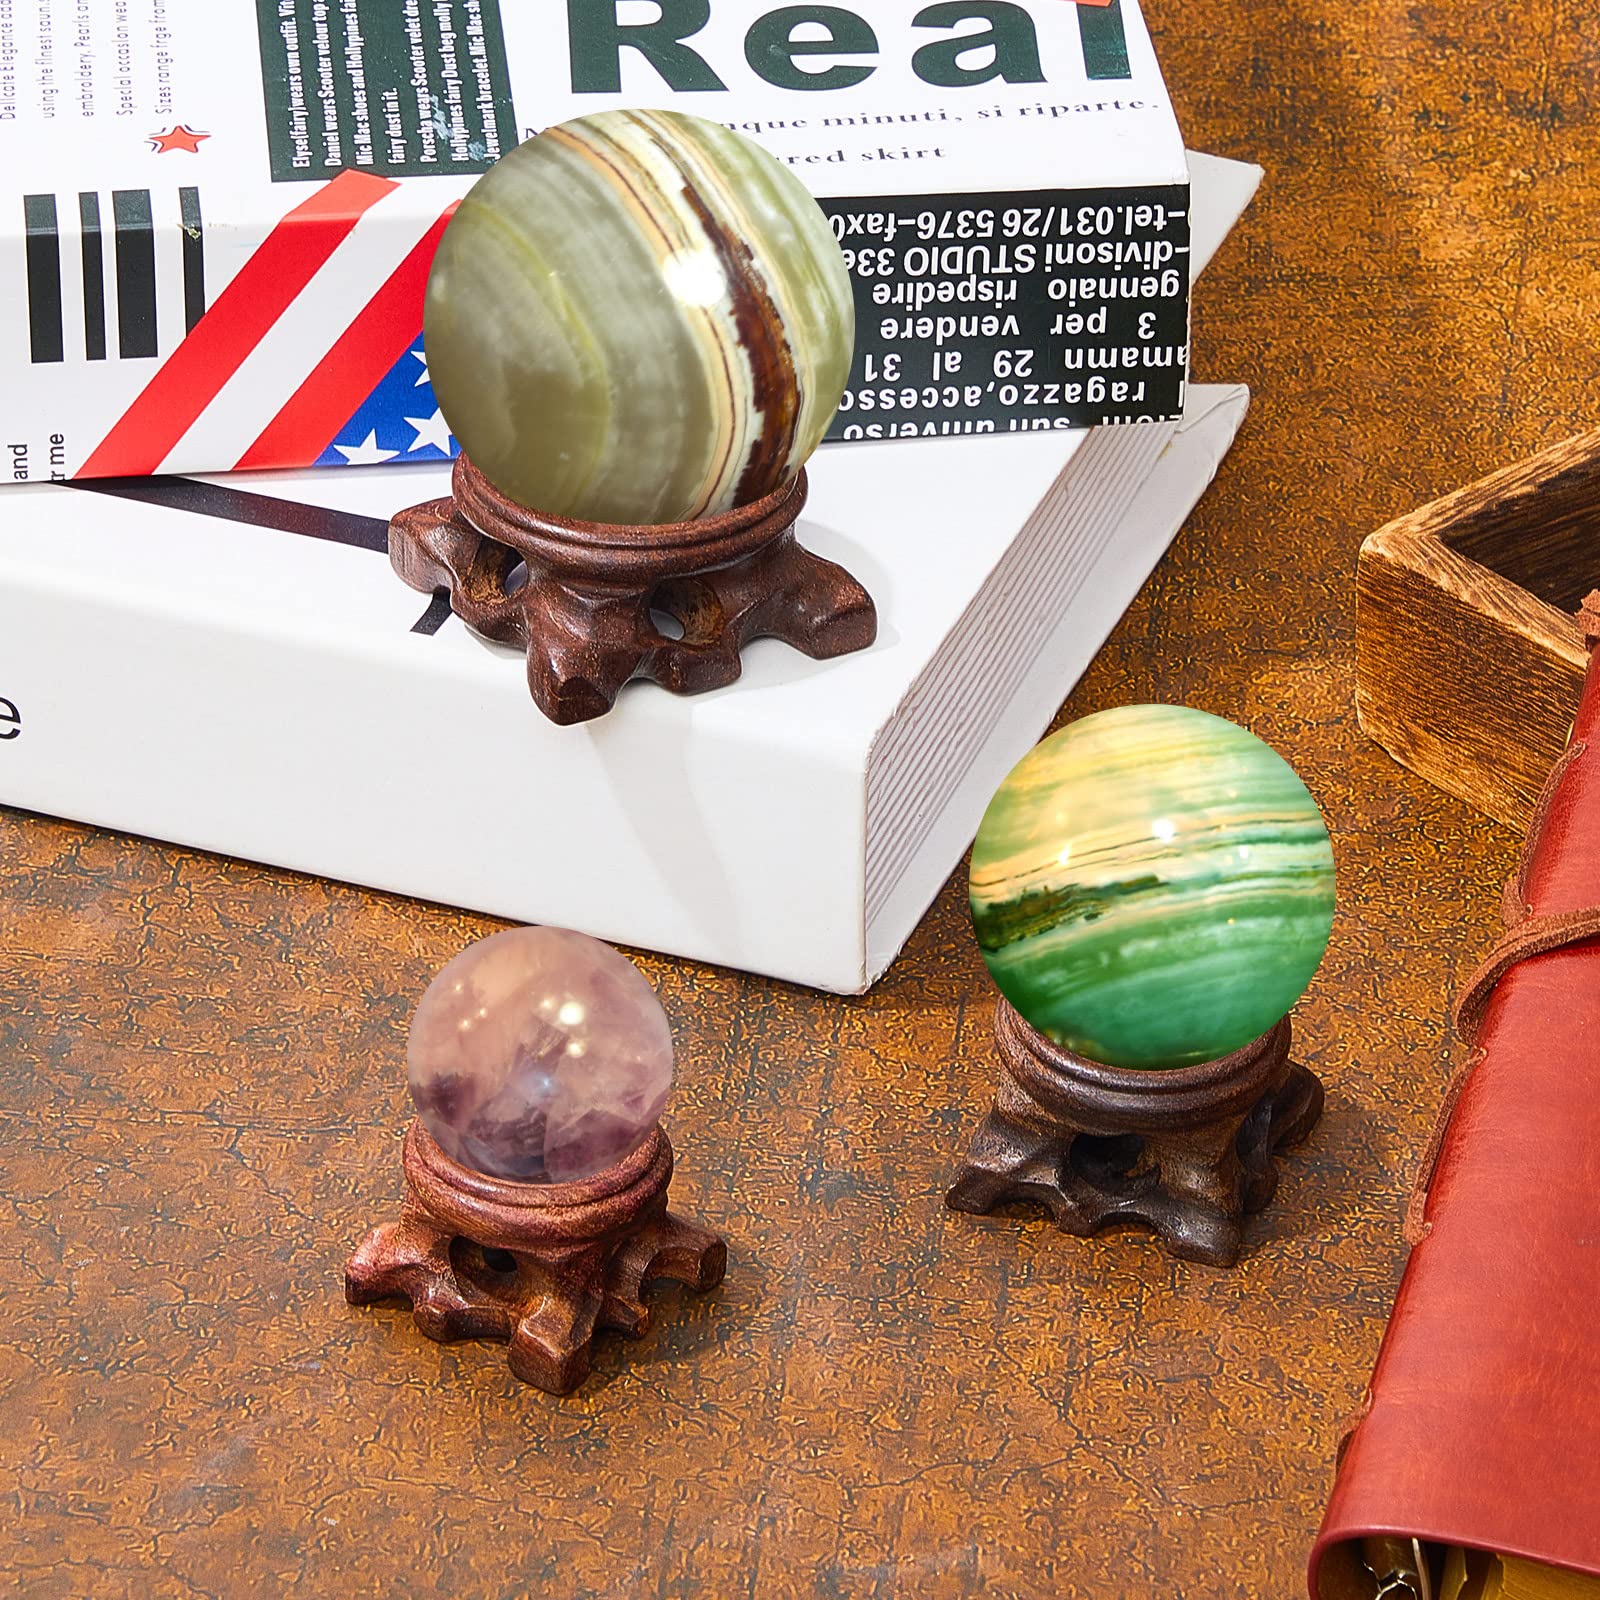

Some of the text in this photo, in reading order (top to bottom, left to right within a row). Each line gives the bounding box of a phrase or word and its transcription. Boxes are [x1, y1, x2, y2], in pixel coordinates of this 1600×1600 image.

[72, 15, 91, 47] Pearls
[280, 17, 299, 51] outfit.
[404, 17, 423, 44] velet
[466, 12, 483, 35] Mac
[342, 13, 365, 68] Hollypines
[567, 0, 1132, 93] Real
[36, 68, 53, 85] the
[157, 51, 173, 83] range
[287, 52, 301, 74] own
[347, 68, 365, 89] and
[409, 45, 428, 86] Scooter
[312, 5, 342, 167] Daniel wears Scooter velour top
[432, 2, 470, 161] Hollypines fairy Dust beg molly
[37, 88, 58, 119] using
[154, 87, 172, 114] Sizes
[351, 90, 369, 122] shoes
[416, 87, 432, 120] wears
[824, 108, 962, 128] minuti,
[977, 105, 1003, 119] si
[1018, 99, 1159, 118] riparte.
[353, 123, 371, 144] Mac
[381, 87, 407, 164] fairy dust in it.
[477, 102, 501, 160] Jewelmark
[355, 144, 374, 165] Mic
[417, 121, 437, 163] Porscha
[861, 146, 948, 162] skirt
[904, 244, 1037, 277] STUDIO
[872, 269, 1180, 312] gennaio rispedire
[880, 306, 1157, 346] 3 per vendere
[865, 352, 902, 382] 31
[932, 350, 963, 381] al
[993, 349, 1034, 379] 29
[7, 444, 28, 480] and
[49, 433, 65, 465] me
